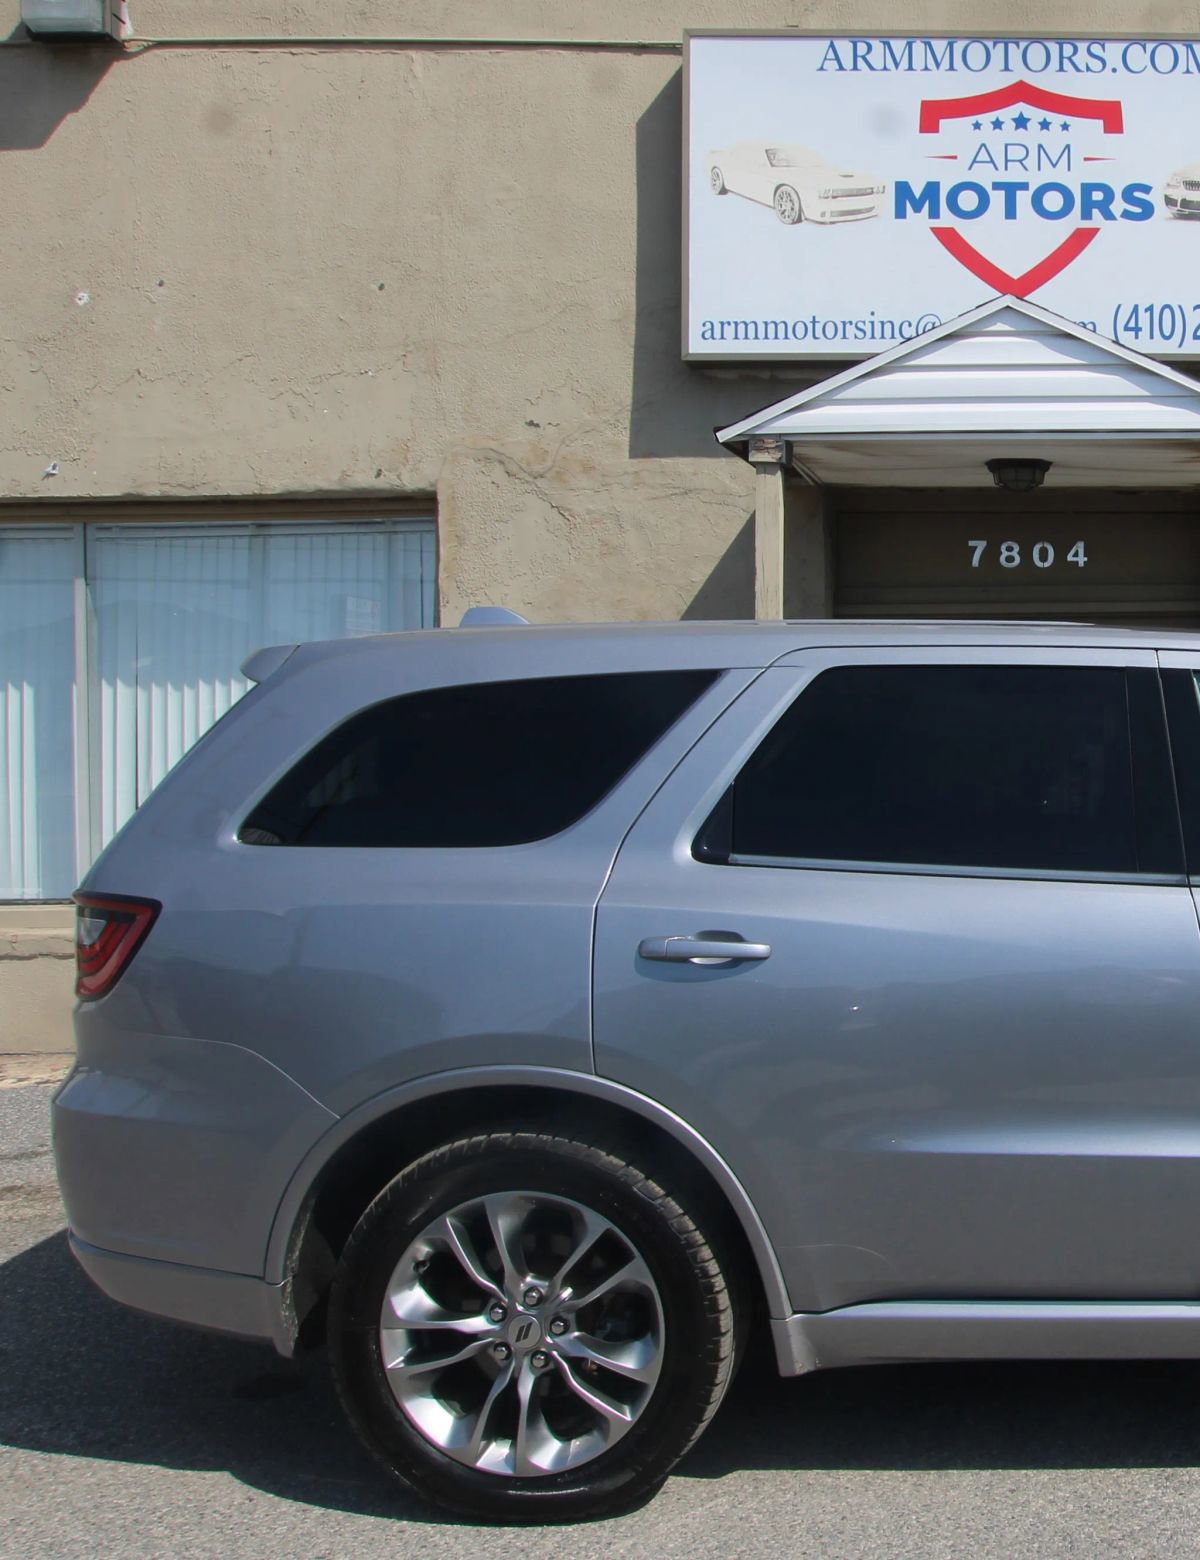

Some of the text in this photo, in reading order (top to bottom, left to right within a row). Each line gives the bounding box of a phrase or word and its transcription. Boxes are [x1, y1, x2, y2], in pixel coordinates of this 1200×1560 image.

[967, 142, 1073, 172] ARM
[893, 179, 1156, 222] MOTORS
[967, 540, 1088, 568] 7804
